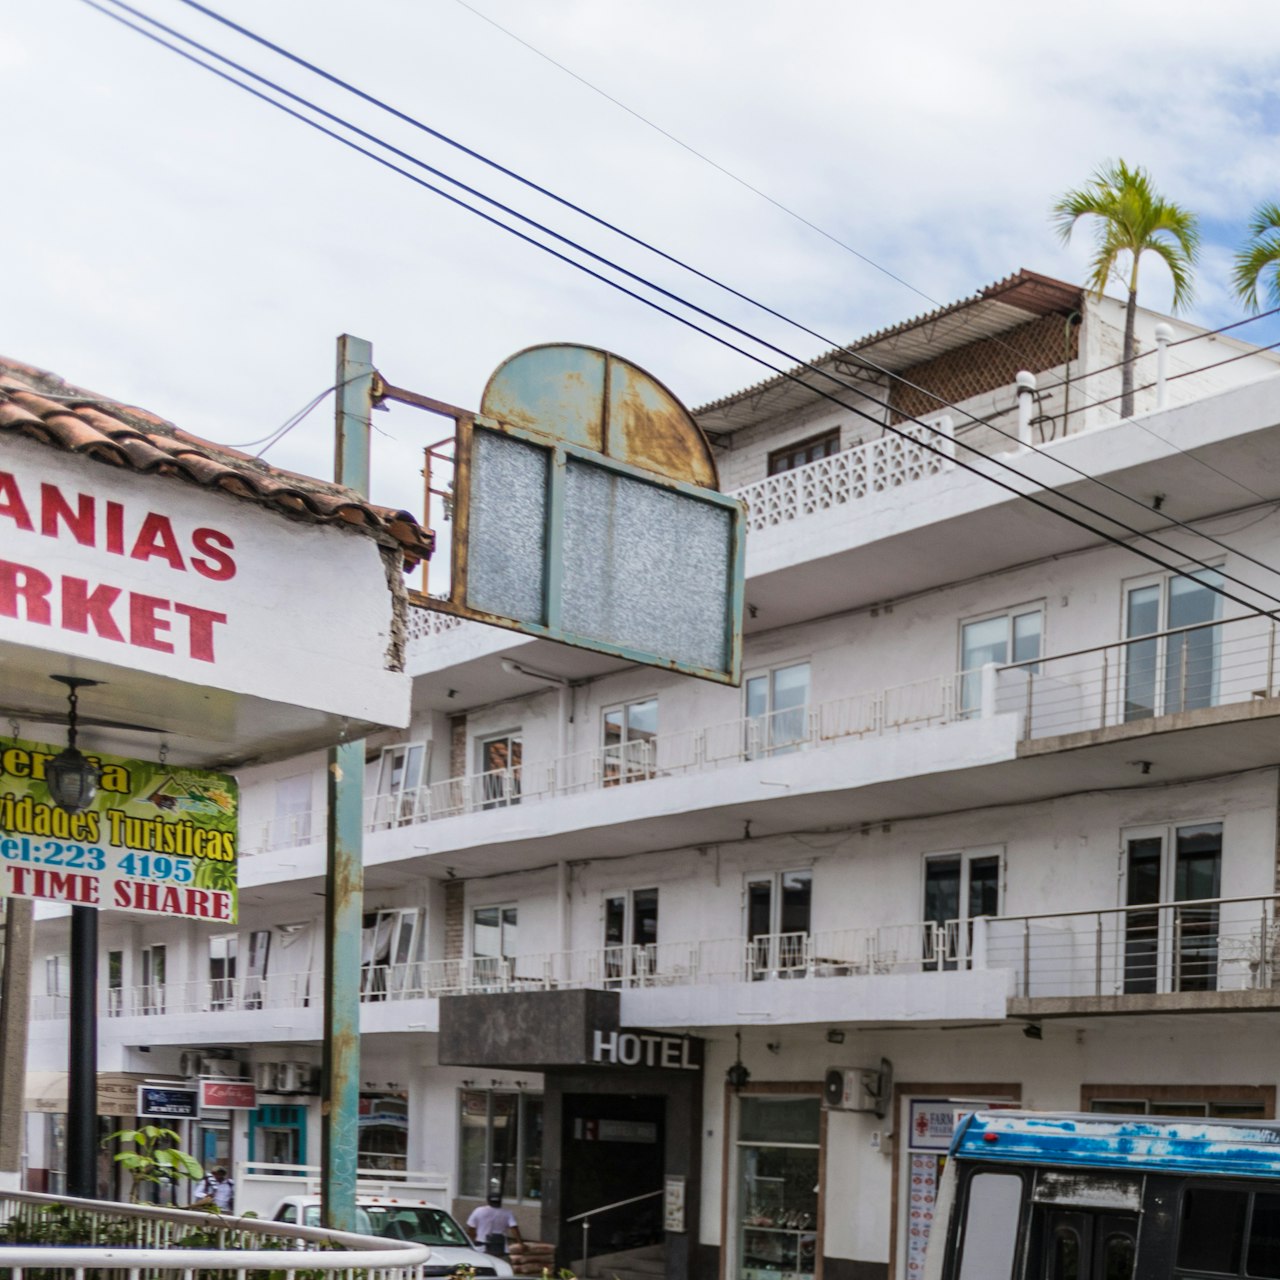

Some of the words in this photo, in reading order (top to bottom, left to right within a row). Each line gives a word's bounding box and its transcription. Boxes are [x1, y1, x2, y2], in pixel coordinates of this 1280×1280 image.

[0, 836, 107, 871] el:223
[117, 852, 193, 883] 4195
[105, 808, 235, 863] Turisticas
[6, 864, 100, 905] TIME
[113, 878, 231, 921] SHARE
[593, 1030, 700, 1070] HOTEL
